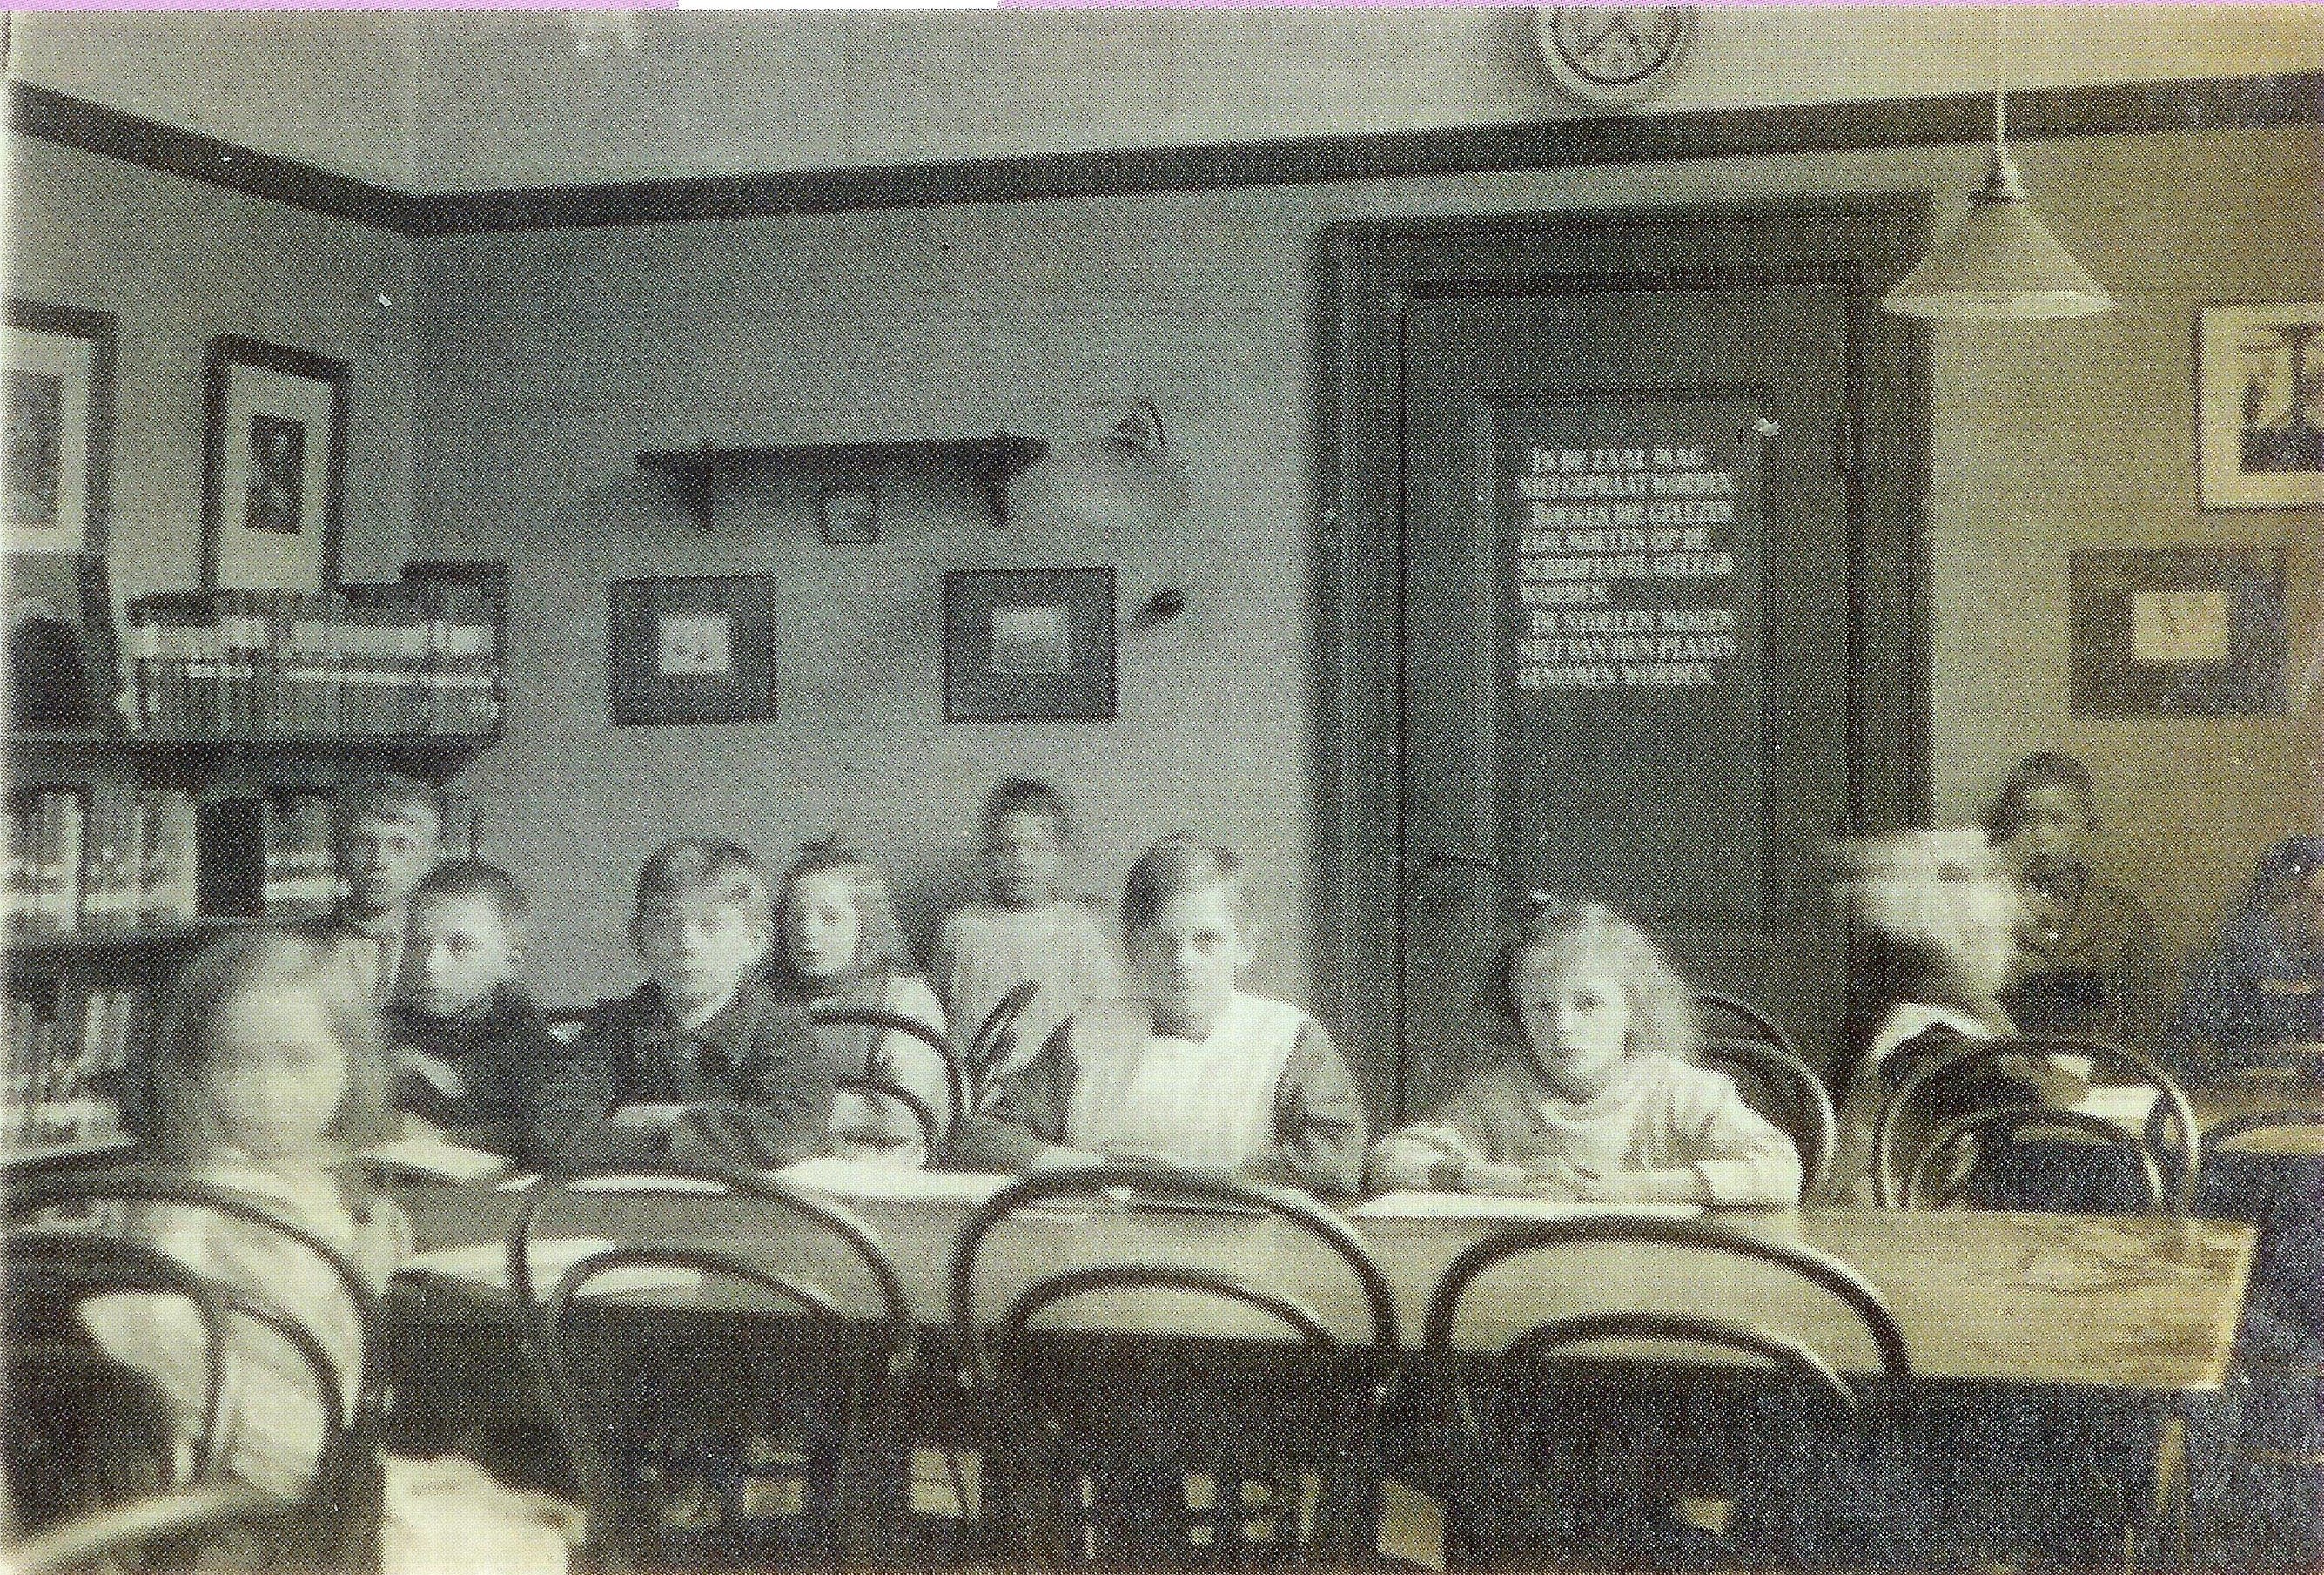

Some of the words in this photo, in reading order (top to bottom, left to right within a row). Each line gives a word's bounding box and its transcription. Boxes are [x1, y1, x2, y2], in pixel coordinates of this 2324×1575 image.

[1531, 448, 1555, 471] IN
[1592, 447, 1644, 469] ZAAL
[1653, 446, 1706, 467] MAG
[1517, 475, 1559, 498] NIET
[1562, 611, 1654, 632] STOELEN
[1517, 638, 1562, 661] NIET
[1568, 637, 1607, 660] VAN
